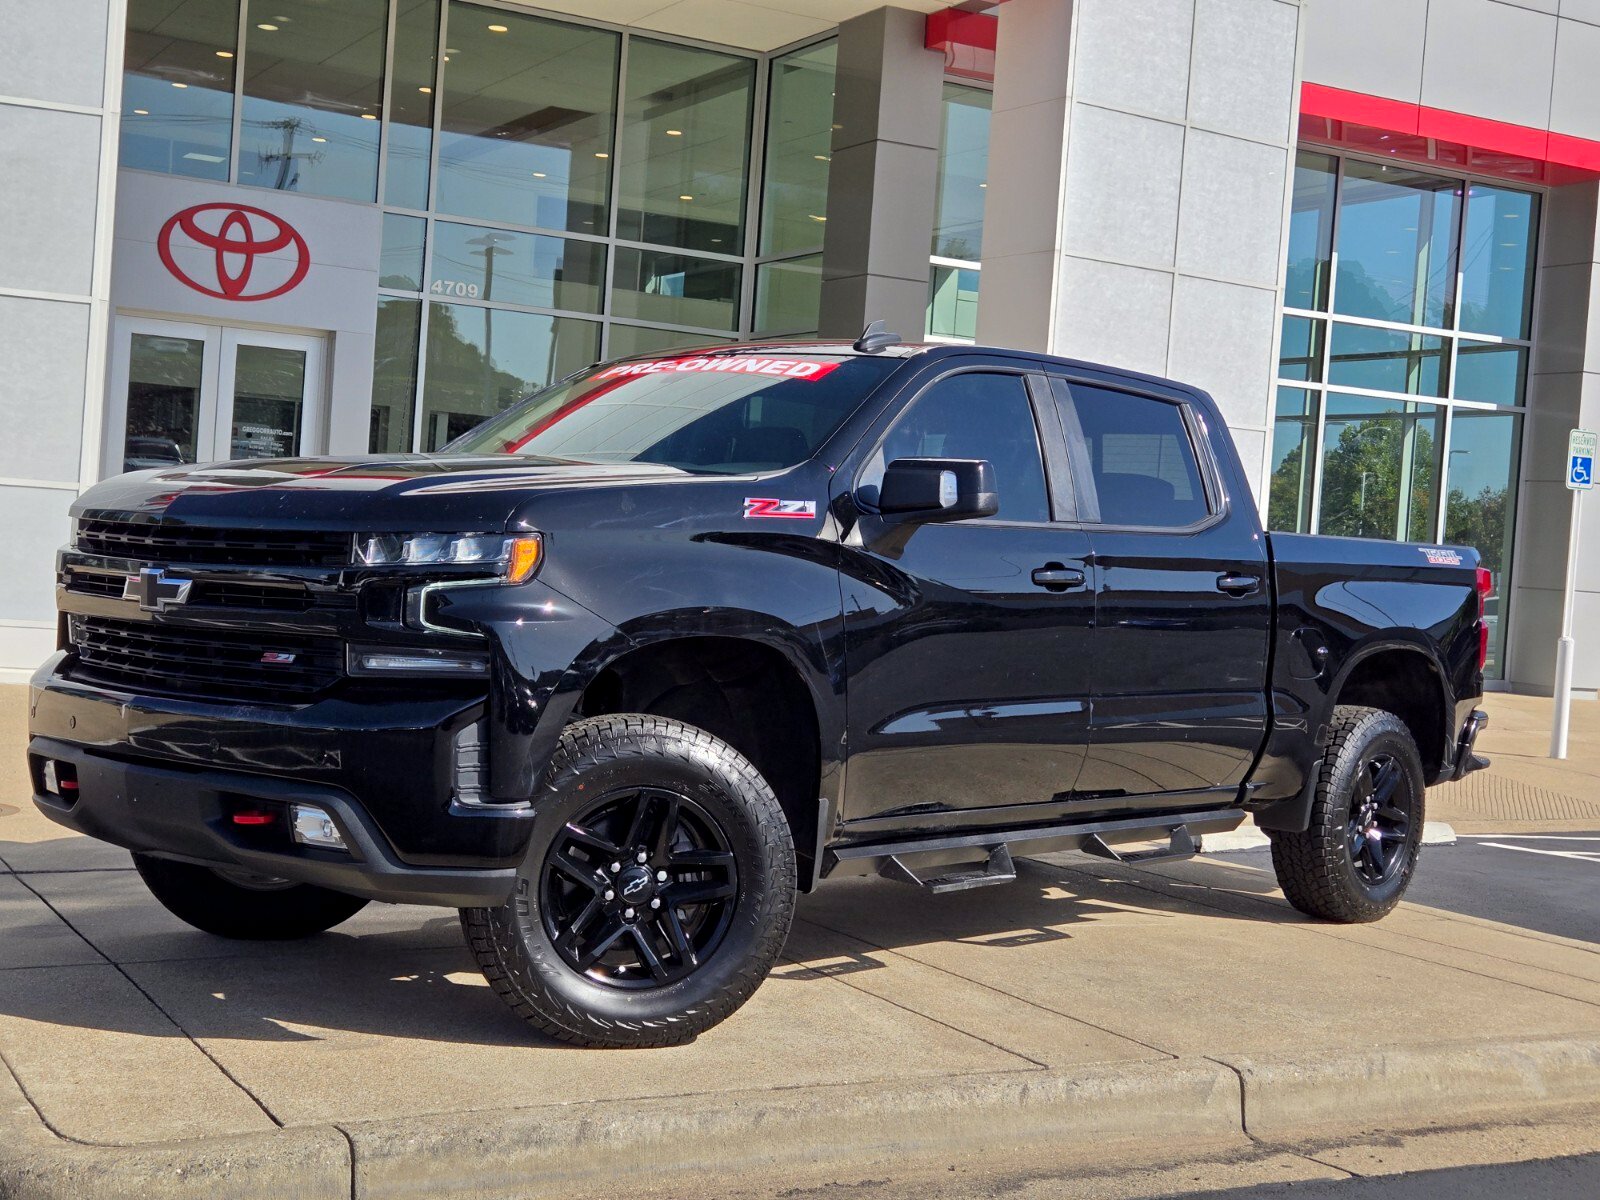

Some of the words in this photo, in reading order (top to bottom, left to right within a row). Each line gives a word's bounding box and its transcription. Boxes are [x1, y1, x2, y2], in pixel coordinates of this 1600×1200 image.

[431, 280, 478, 298] 4709
[598, 357, 822, 379] PRE-OWNED
[743, 497, 816, 518] Z71
